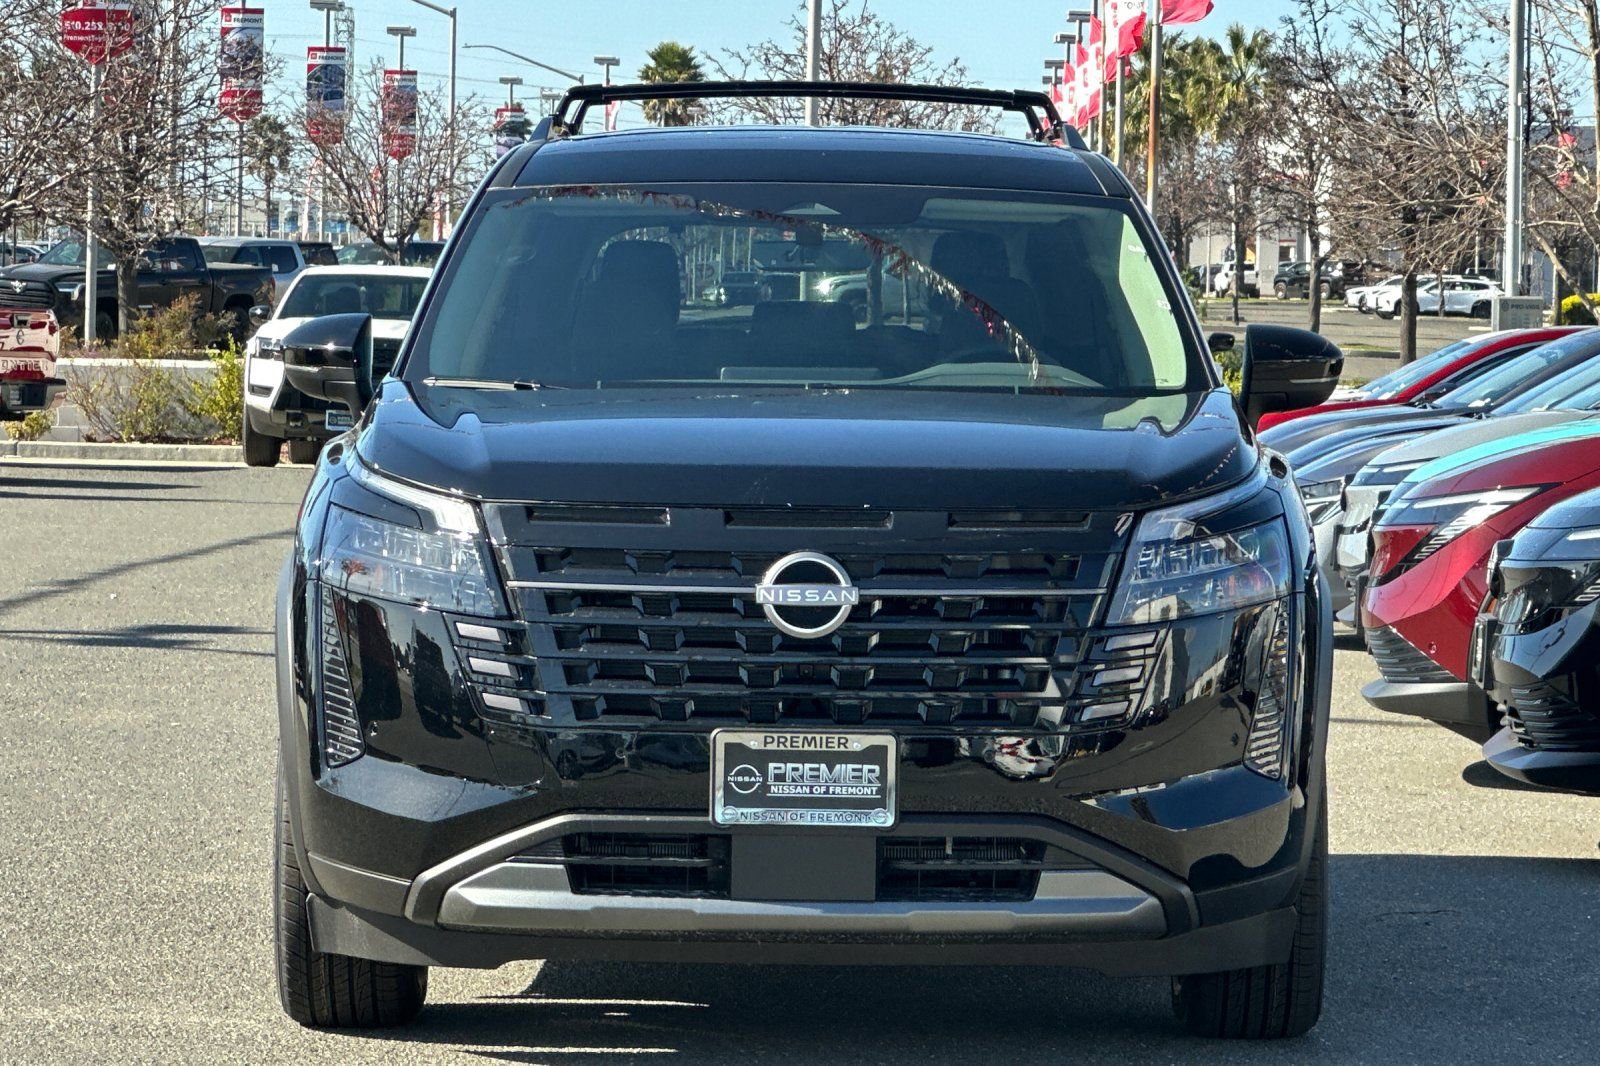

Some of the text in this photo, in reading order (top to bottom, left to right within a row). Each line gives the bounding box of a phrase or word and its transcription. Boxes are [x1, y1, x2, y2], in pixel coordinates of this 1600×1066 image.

[759, 589, 856, 602] NISSAN
[763, 735, 849, 749] PREMIER
[767, 762, 881, 785] PREMIER
[770, 785, 878, 795] NISSAN OF FREMONT
[740, 811, 786, 821] NISSAN
[789, 812, 807, 822] OF
[810, 812, 871, 823] FREMONT
